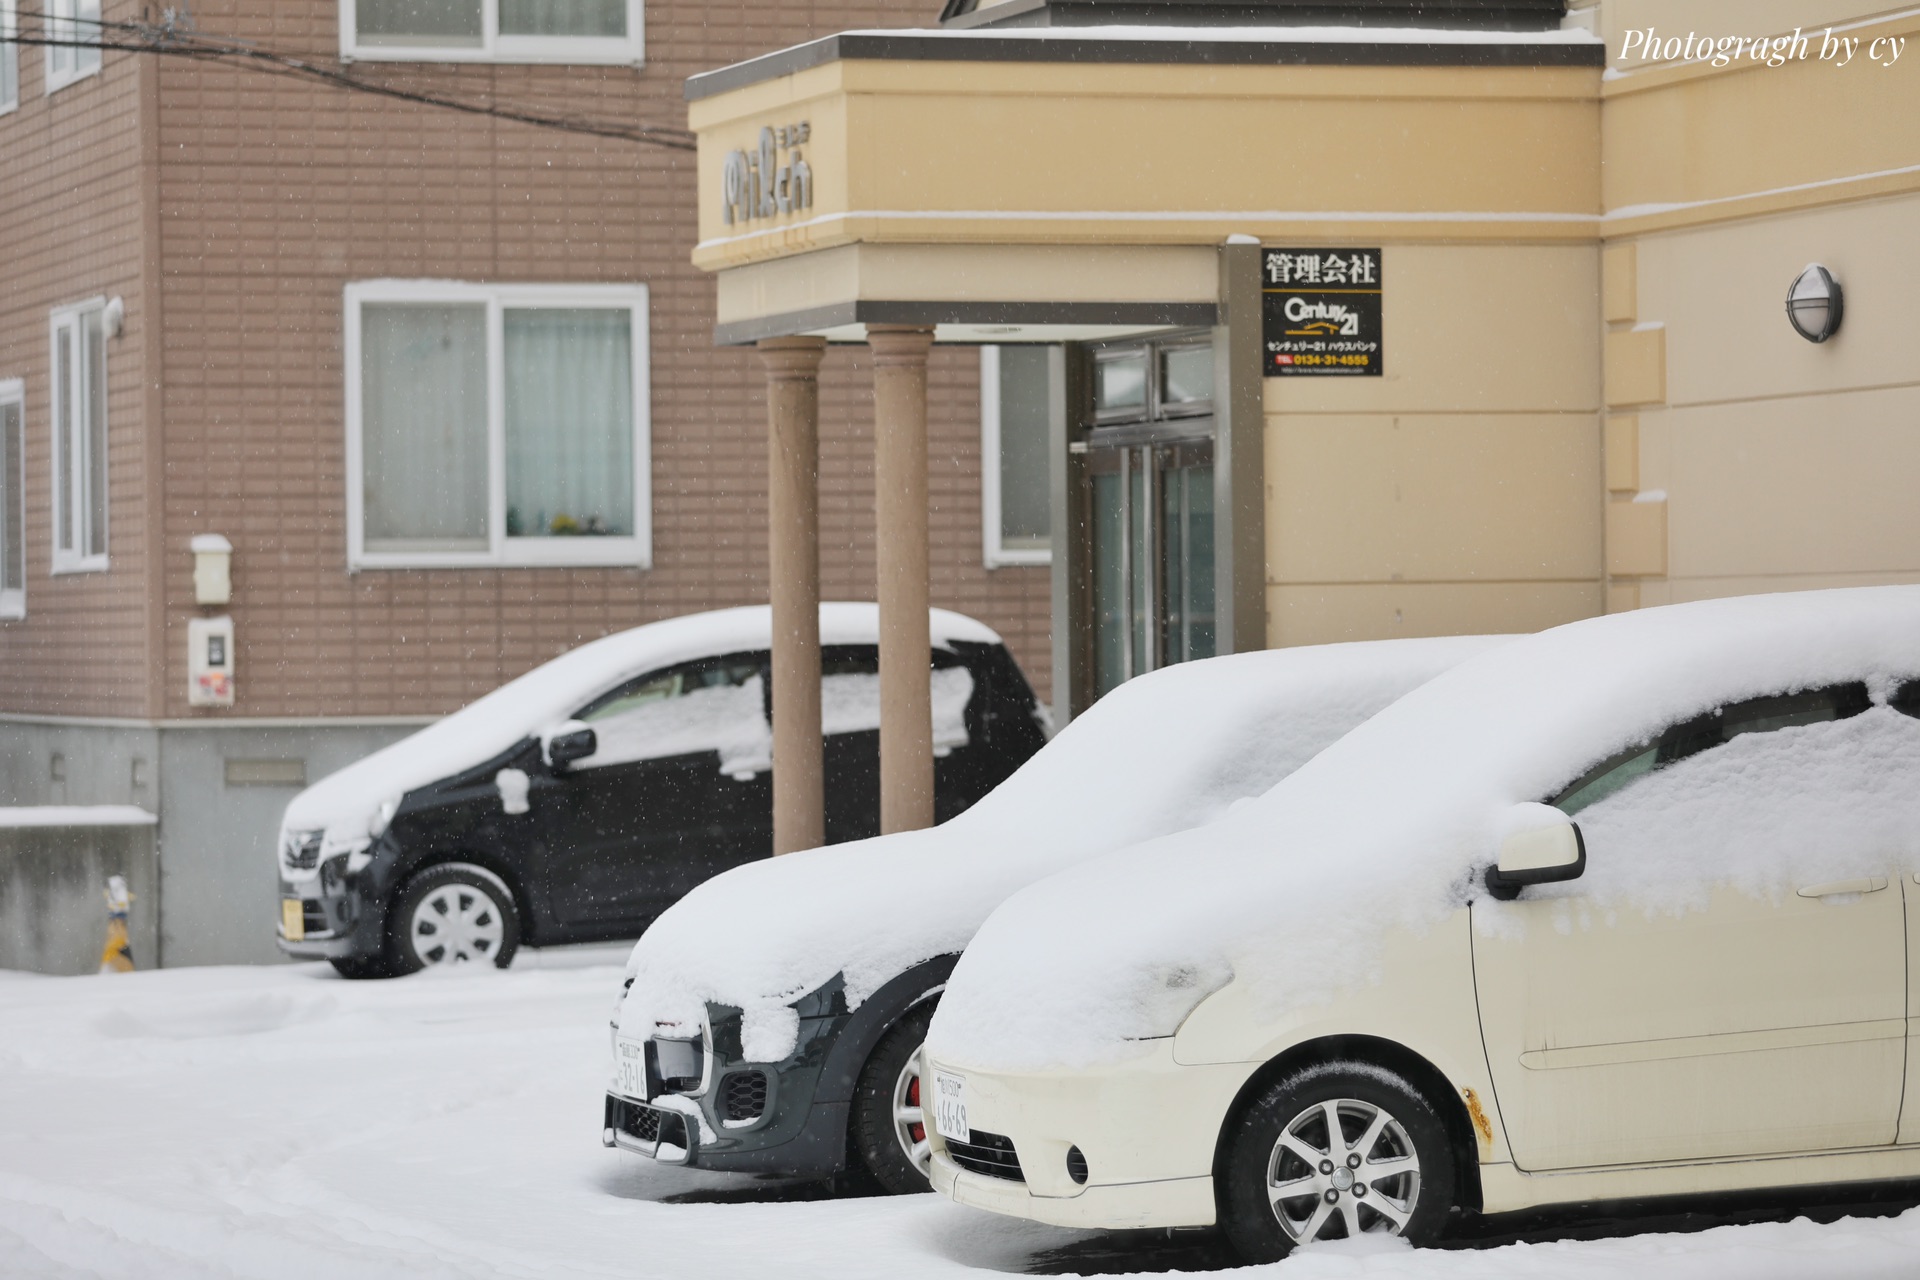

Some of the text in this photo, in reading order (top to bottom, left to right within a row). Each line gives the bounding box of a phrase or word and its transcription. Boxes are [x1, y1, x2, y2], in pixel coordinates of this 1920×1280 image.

[1266, 253, 1376, 284] 管理会社
[1284, 297, 1359, 335] Century 21
[1267, 341, 1326, 352] センチュリー21
[942, 1100, 967, 1136] 66-69
